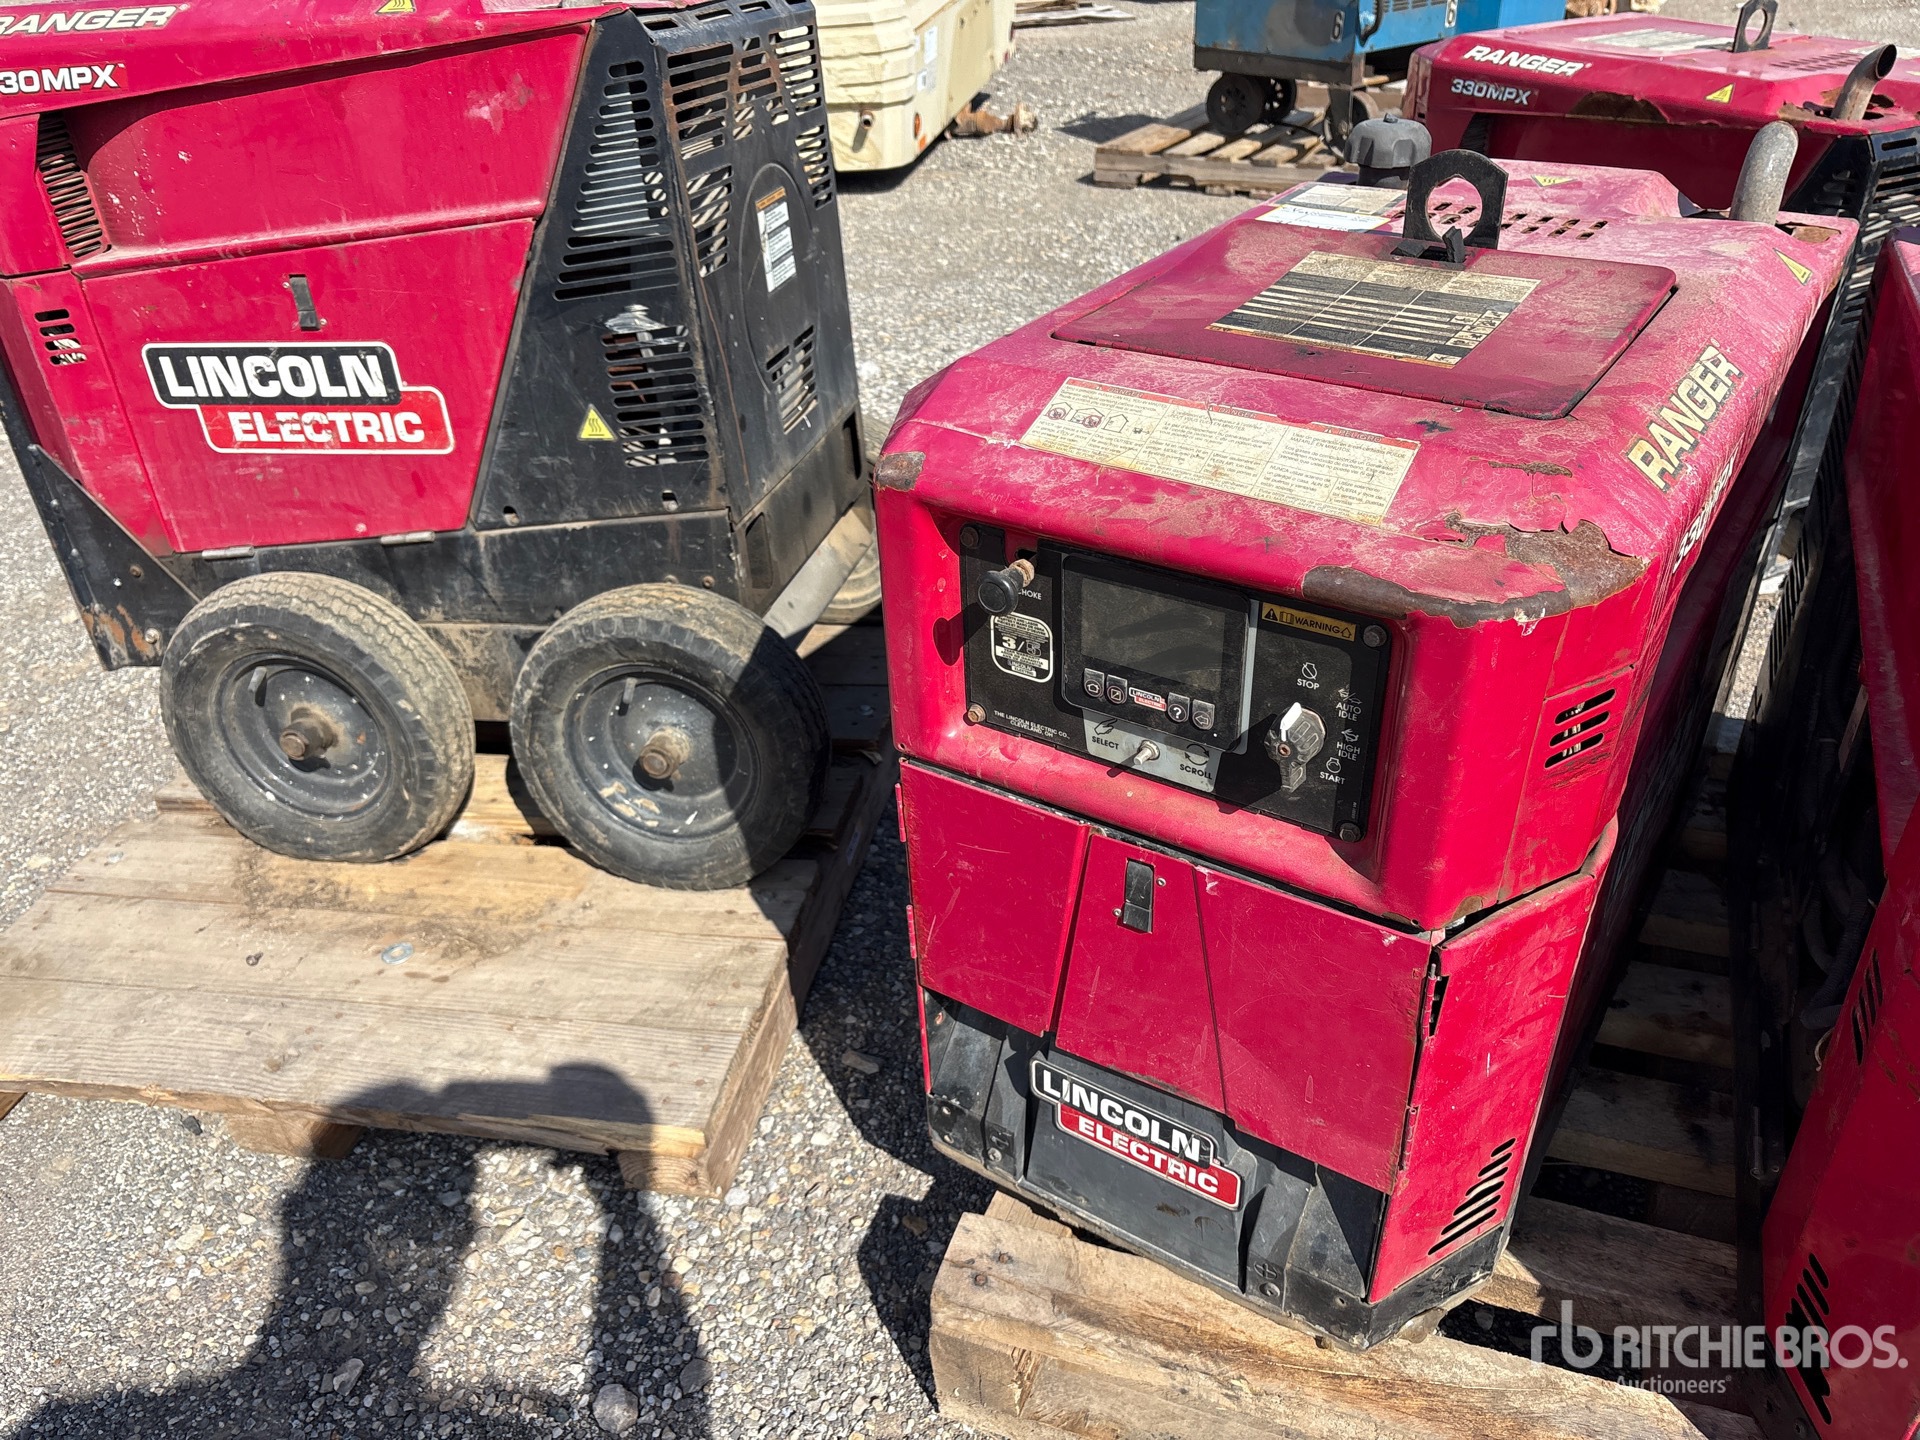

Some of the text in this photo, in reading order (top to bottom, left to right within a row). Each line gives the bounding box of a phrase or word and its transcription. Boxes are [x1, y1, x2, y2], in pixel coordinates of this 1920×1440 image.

[1463, 46, 1585, 76] RANGER
[1451, 78, 1532, 106] 330MPX
[158, 354, 388, 398] LINCOLN
[1217, 407, 1257, 418] DANGER
[1627, 344, 1744, 492] RANGER
[227, 411, 425, 443] ELECTRIC
[1337, 429, 1382, 442] PELIGRO
[1018, 589, 1042, 600] HOKE
[1295, 616, 1341, 635] WARNING
[1297, 678, 1320, 690] STOP
[1132, 690, 1160, 702] LINCOLN
[1138, 697, 1163, 709] ELECTRIC
[1336, 703, 1362, 715] AUTO
[1338, 709, 1358, 722] IDLE
[994, 710, 1005, 718] THE
[1005, 713, 1029, 726] LINCOLN
[1030, 721, 1058, 735] ELECTRIC
[1092, 736, 1119, 750] SELECT
[1337, 742, 1361, 755] HIGH
[1338, 750, 1358, 762] IDLE
[1180, 764, 1213, 780] SCROLL
[1320, 771, 1346, 785] START
[1043, 1069, 1200, 1162] LINCOLN
[1078, 1115, 1219, 1194] ELECTRIC
